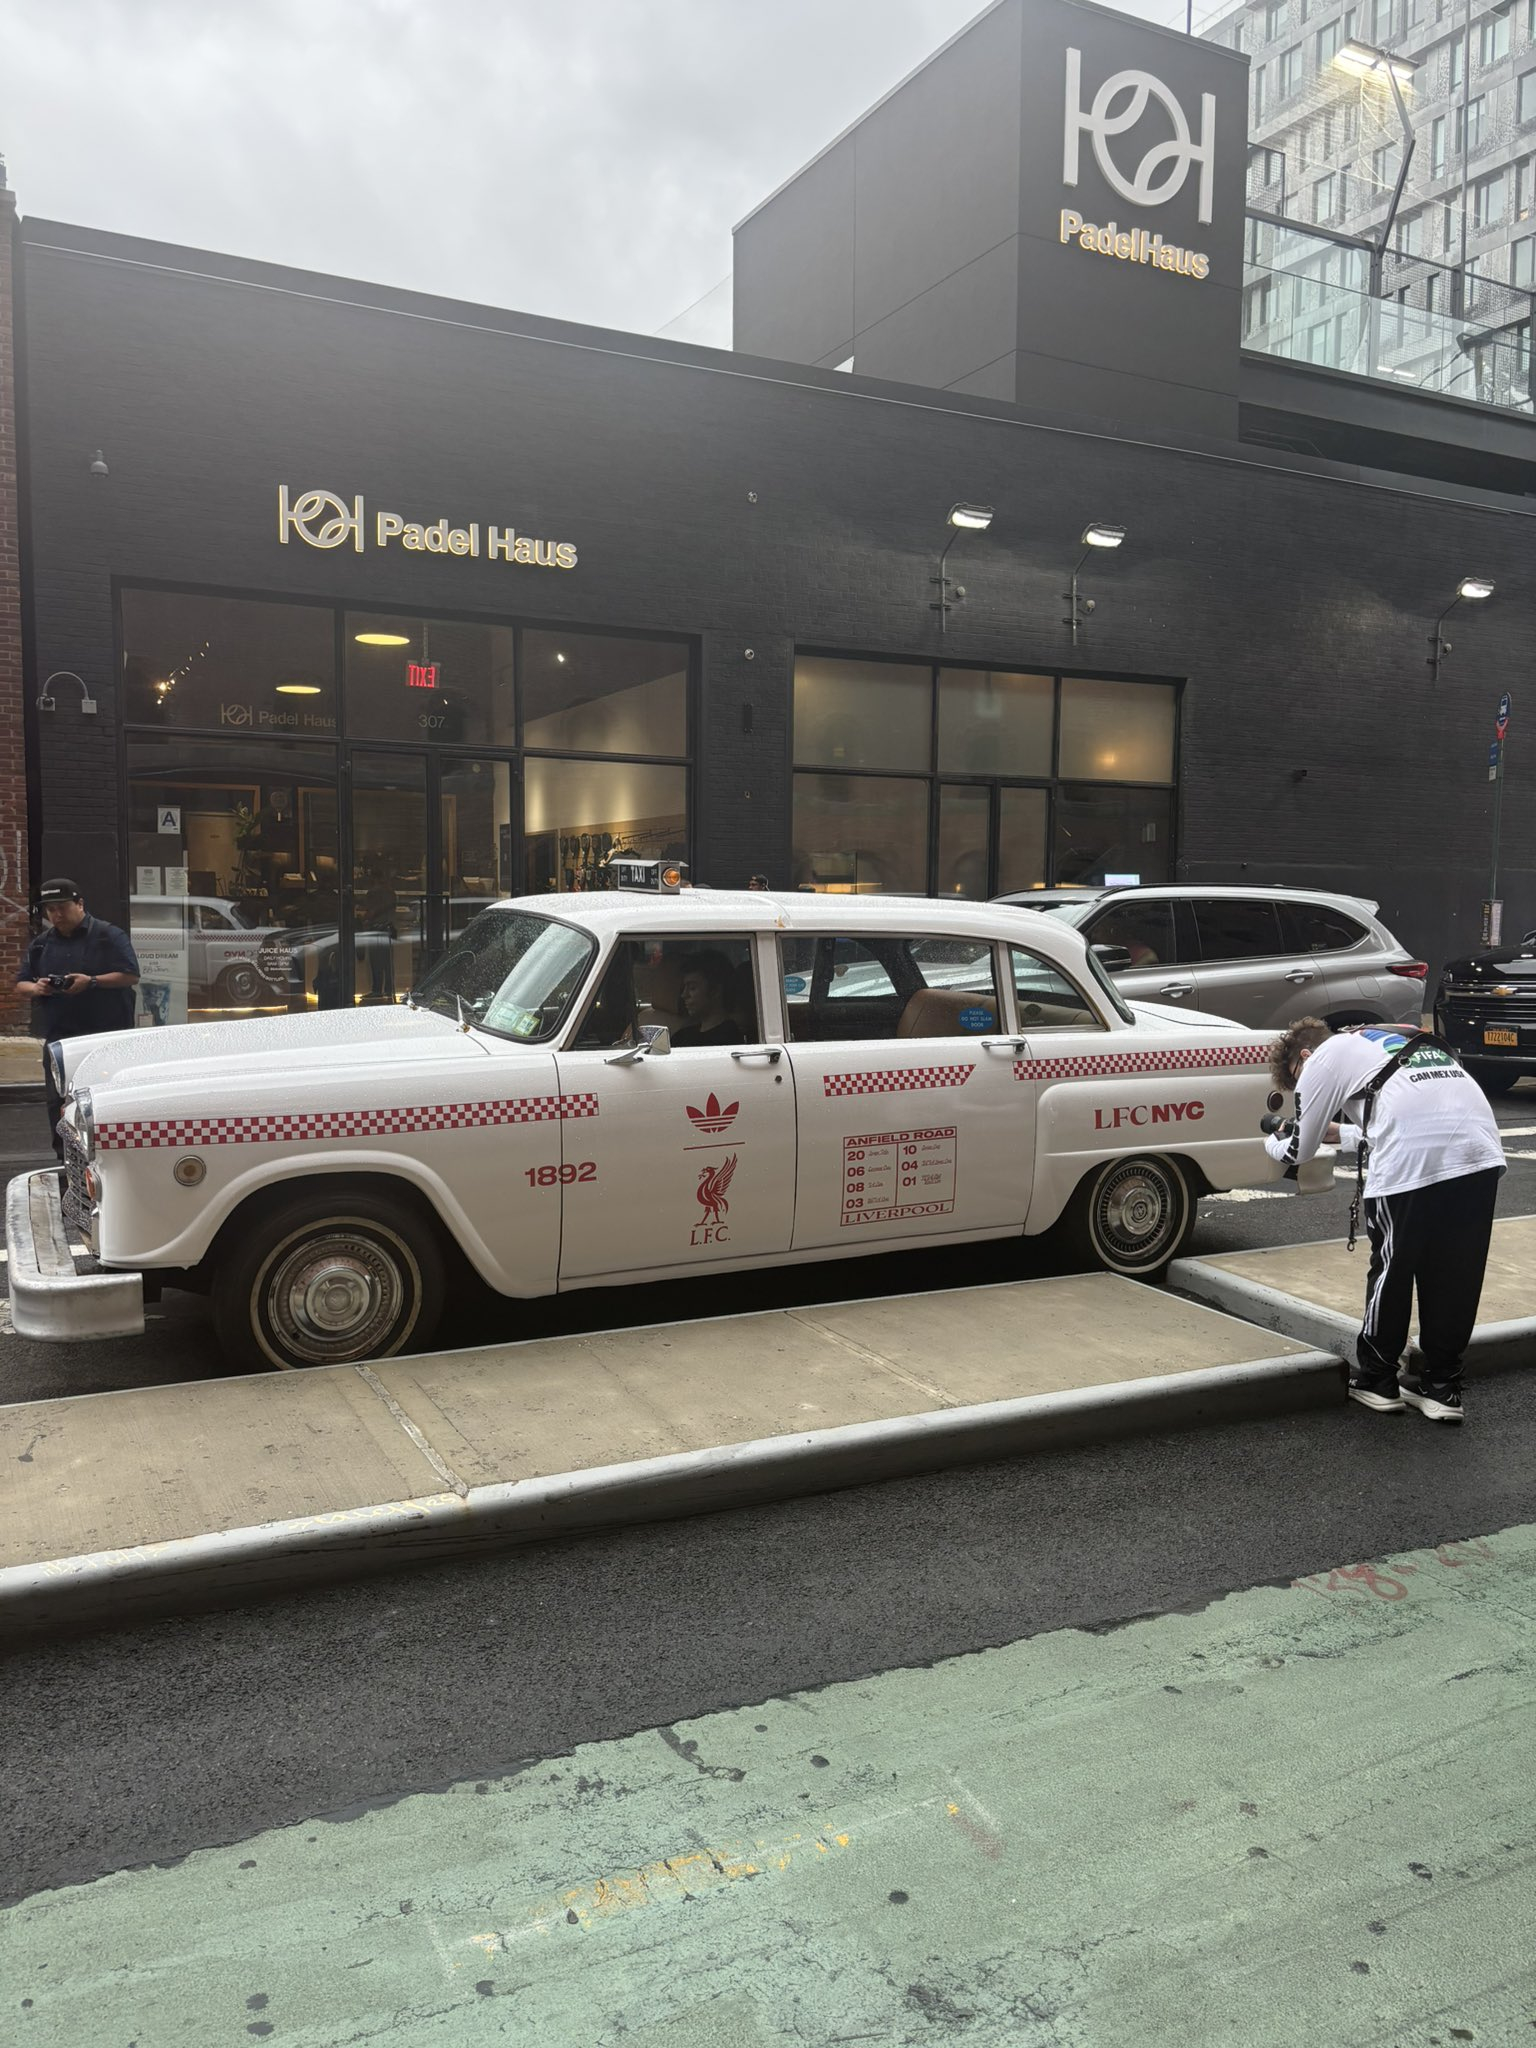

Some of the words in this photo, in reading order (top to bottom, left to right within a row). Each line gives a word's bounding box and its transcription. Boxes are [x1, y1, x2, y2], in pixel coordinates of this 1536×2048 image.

[377, 511, 480, 557] Padel
[488, 525, 578, 569] Haus
[258, 711, 298, 726] Padel
[304, 714, 336, 728] Haus
[418, 714, 445, 728] 307
[161, 811, 177, 826] A
[630, 865, 646, 883] TAXI
[1415, 1050, 1441, 1061] FIFA
[1409, 1071, 1430, 1083] CAN
[1430, 1070, 1451, 1080] MEX
[846, 1133, 910, 1147] ANFIELD
[913, 1128, 954, 1140] ROAD
[847, 1150, 866, 1161] 20
[902, 1145, 917, 1155] 10
[847, 1166, 866, 1177] 06
[901, 1161, 919, 1172] 04
[525, 1161, 597, 1187] 1892
[846, 1182, 865, 1193] 08
[902, 1176, 917, 1187] 01
[846, 1197, 864, 1209] 03
[844, 1203, 950, 1224] LIVERPOOL
